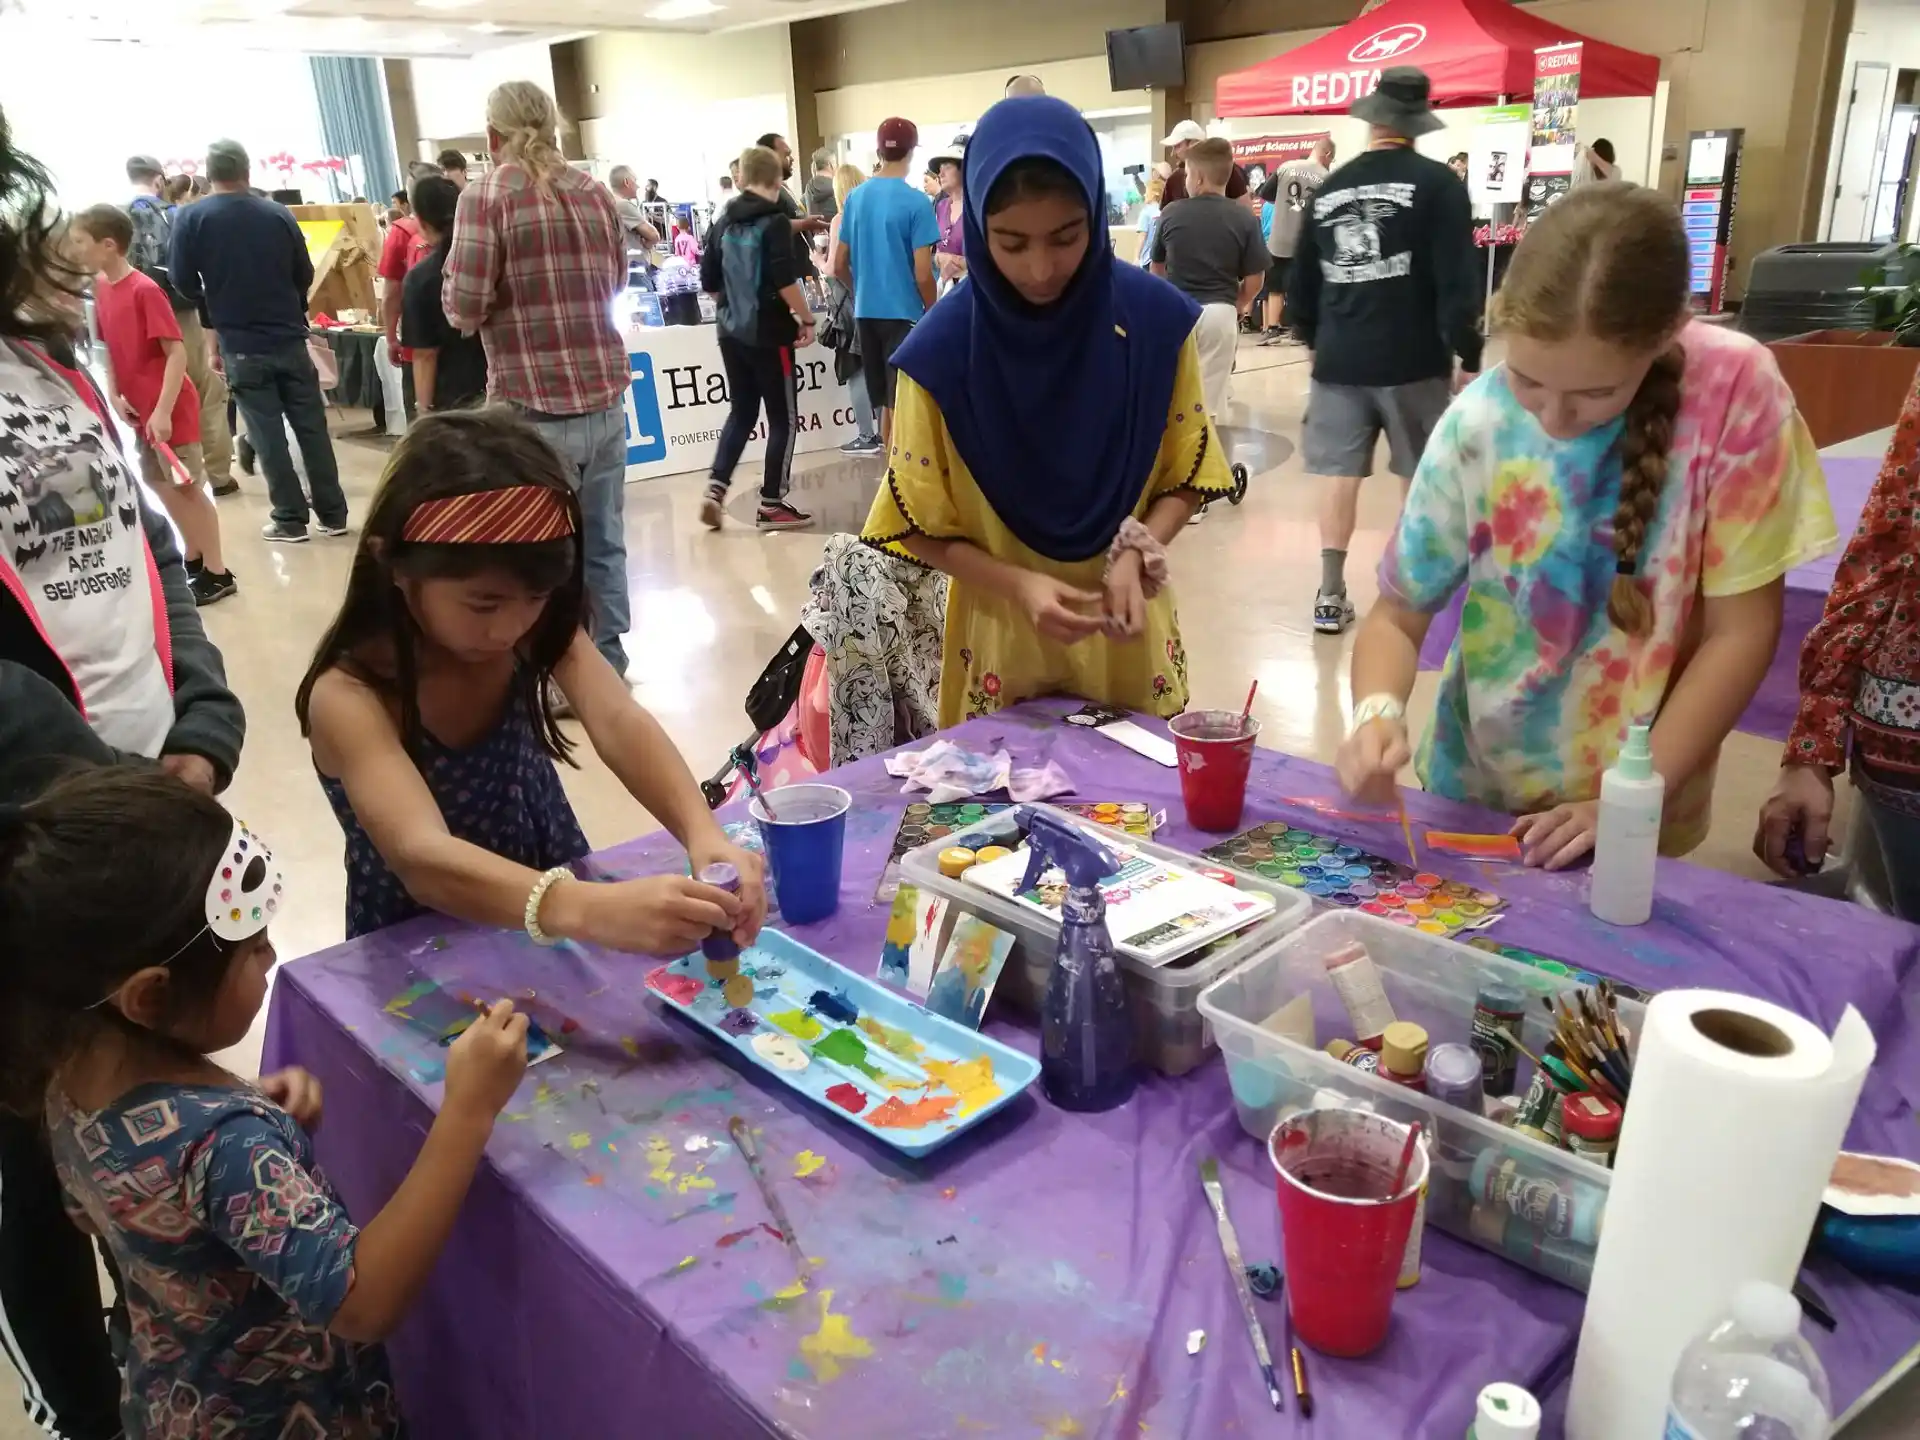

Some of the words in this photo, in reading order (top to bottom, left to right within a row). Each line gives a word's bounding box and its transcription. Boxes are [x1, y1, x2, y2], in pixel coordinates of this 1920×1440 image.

[1547, 54, 1580, 69] REDTAIL
[1292, 68, 1383, 107] REDTA
[1245, 143, 1265, 155] your
[1265, 141, 1298, 151] Science
[1299, 140, 1317, 150] Her
[662, 360, 827, 410] Haer
[52, 530, 75, 554] THE
